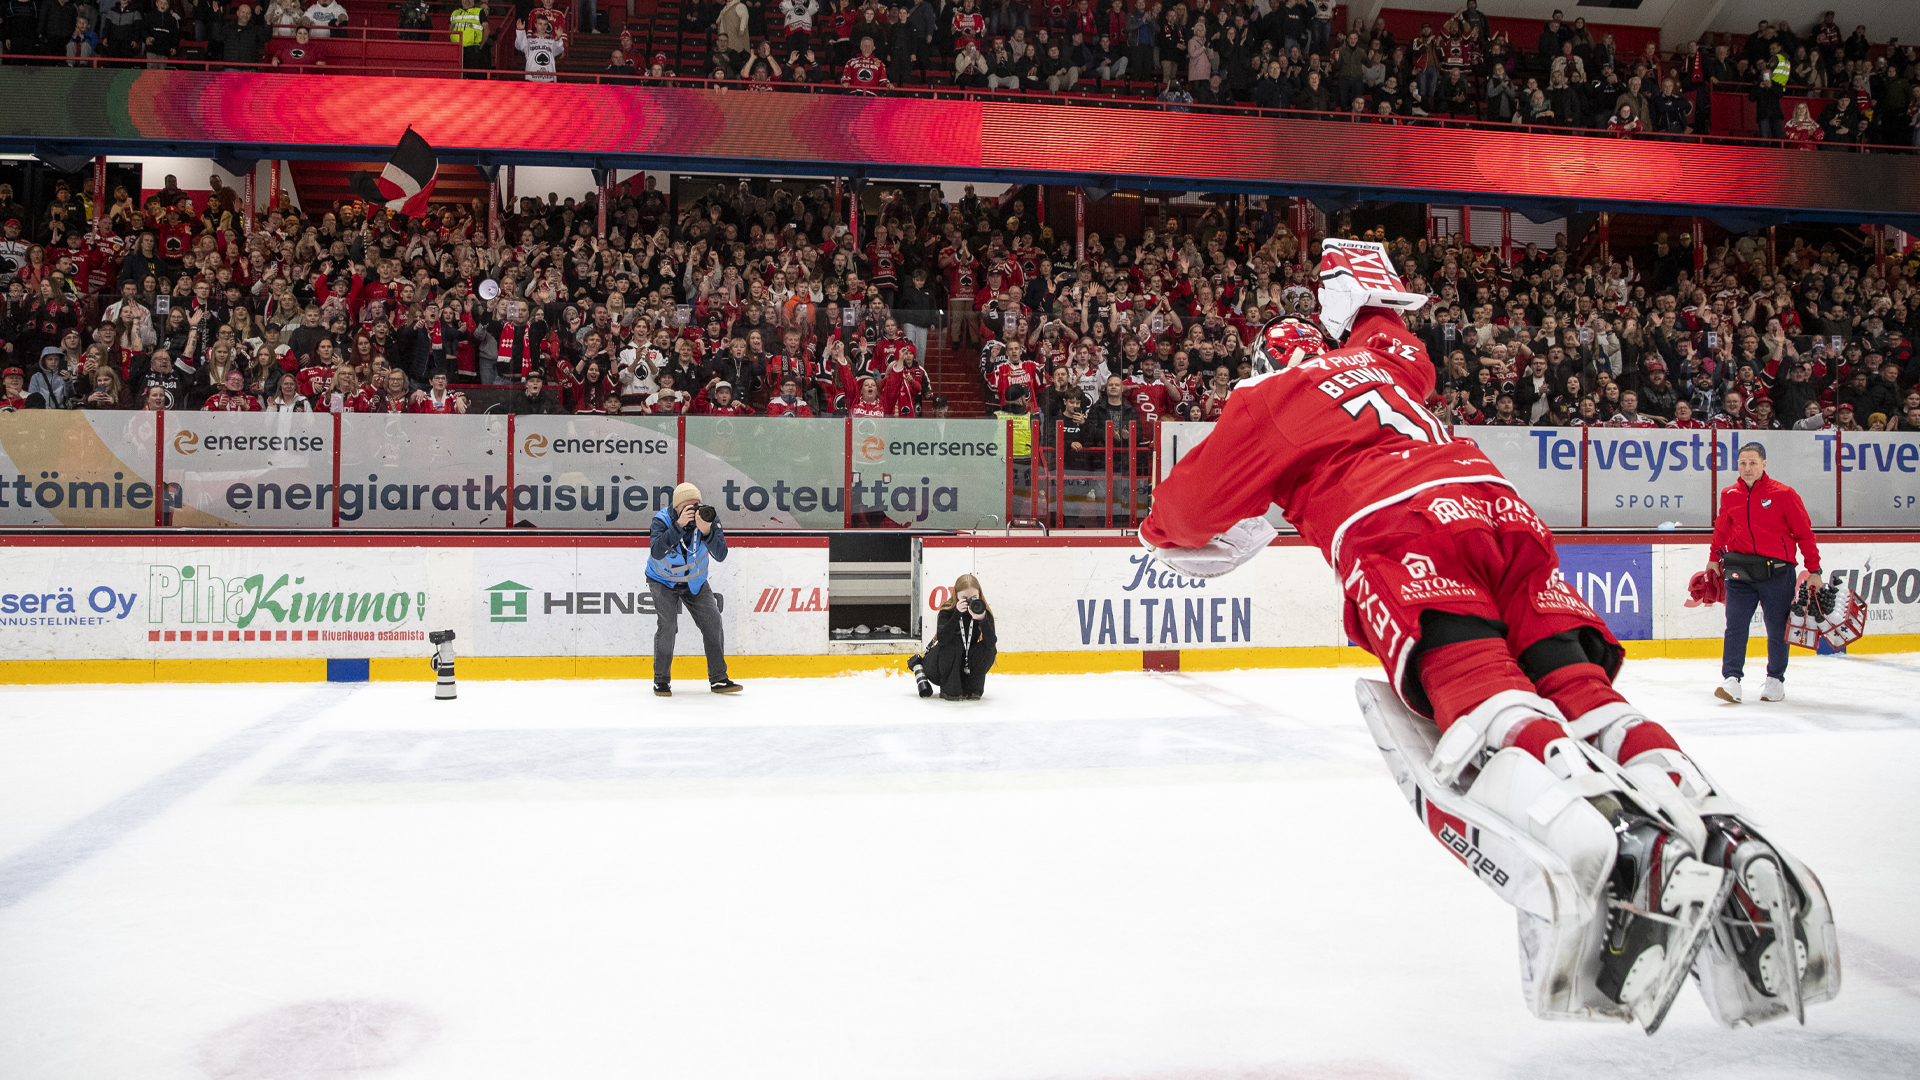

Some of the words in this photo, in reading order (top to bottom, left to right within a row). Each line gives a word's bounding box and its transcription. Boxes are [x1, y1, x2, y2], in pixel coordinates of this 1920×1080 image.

[204, 432, 324, 452] enersense
[553, 438, 668, 454] enersense
[889, 440, 998, 457] enersense
[1814, 434, 1920, 472] Terve
[225, 474, 675, 521] energiaratkaisujen
[723, 477, 958, 521] toteuttaja
[1615, 494, 1684, 508] SPORT
[1400, 578, 1466, 595] ASTOR
[1830, 568, 1920, 605] URO
[88, 585, 137, 619] Oy
[544, 591, 724, 615] HENS
[1077, 597, 1252, 644] VALTANEN
[322, 630, 375, 642] Kivenkovaa
[378, 631, 425, 642] osaamista
